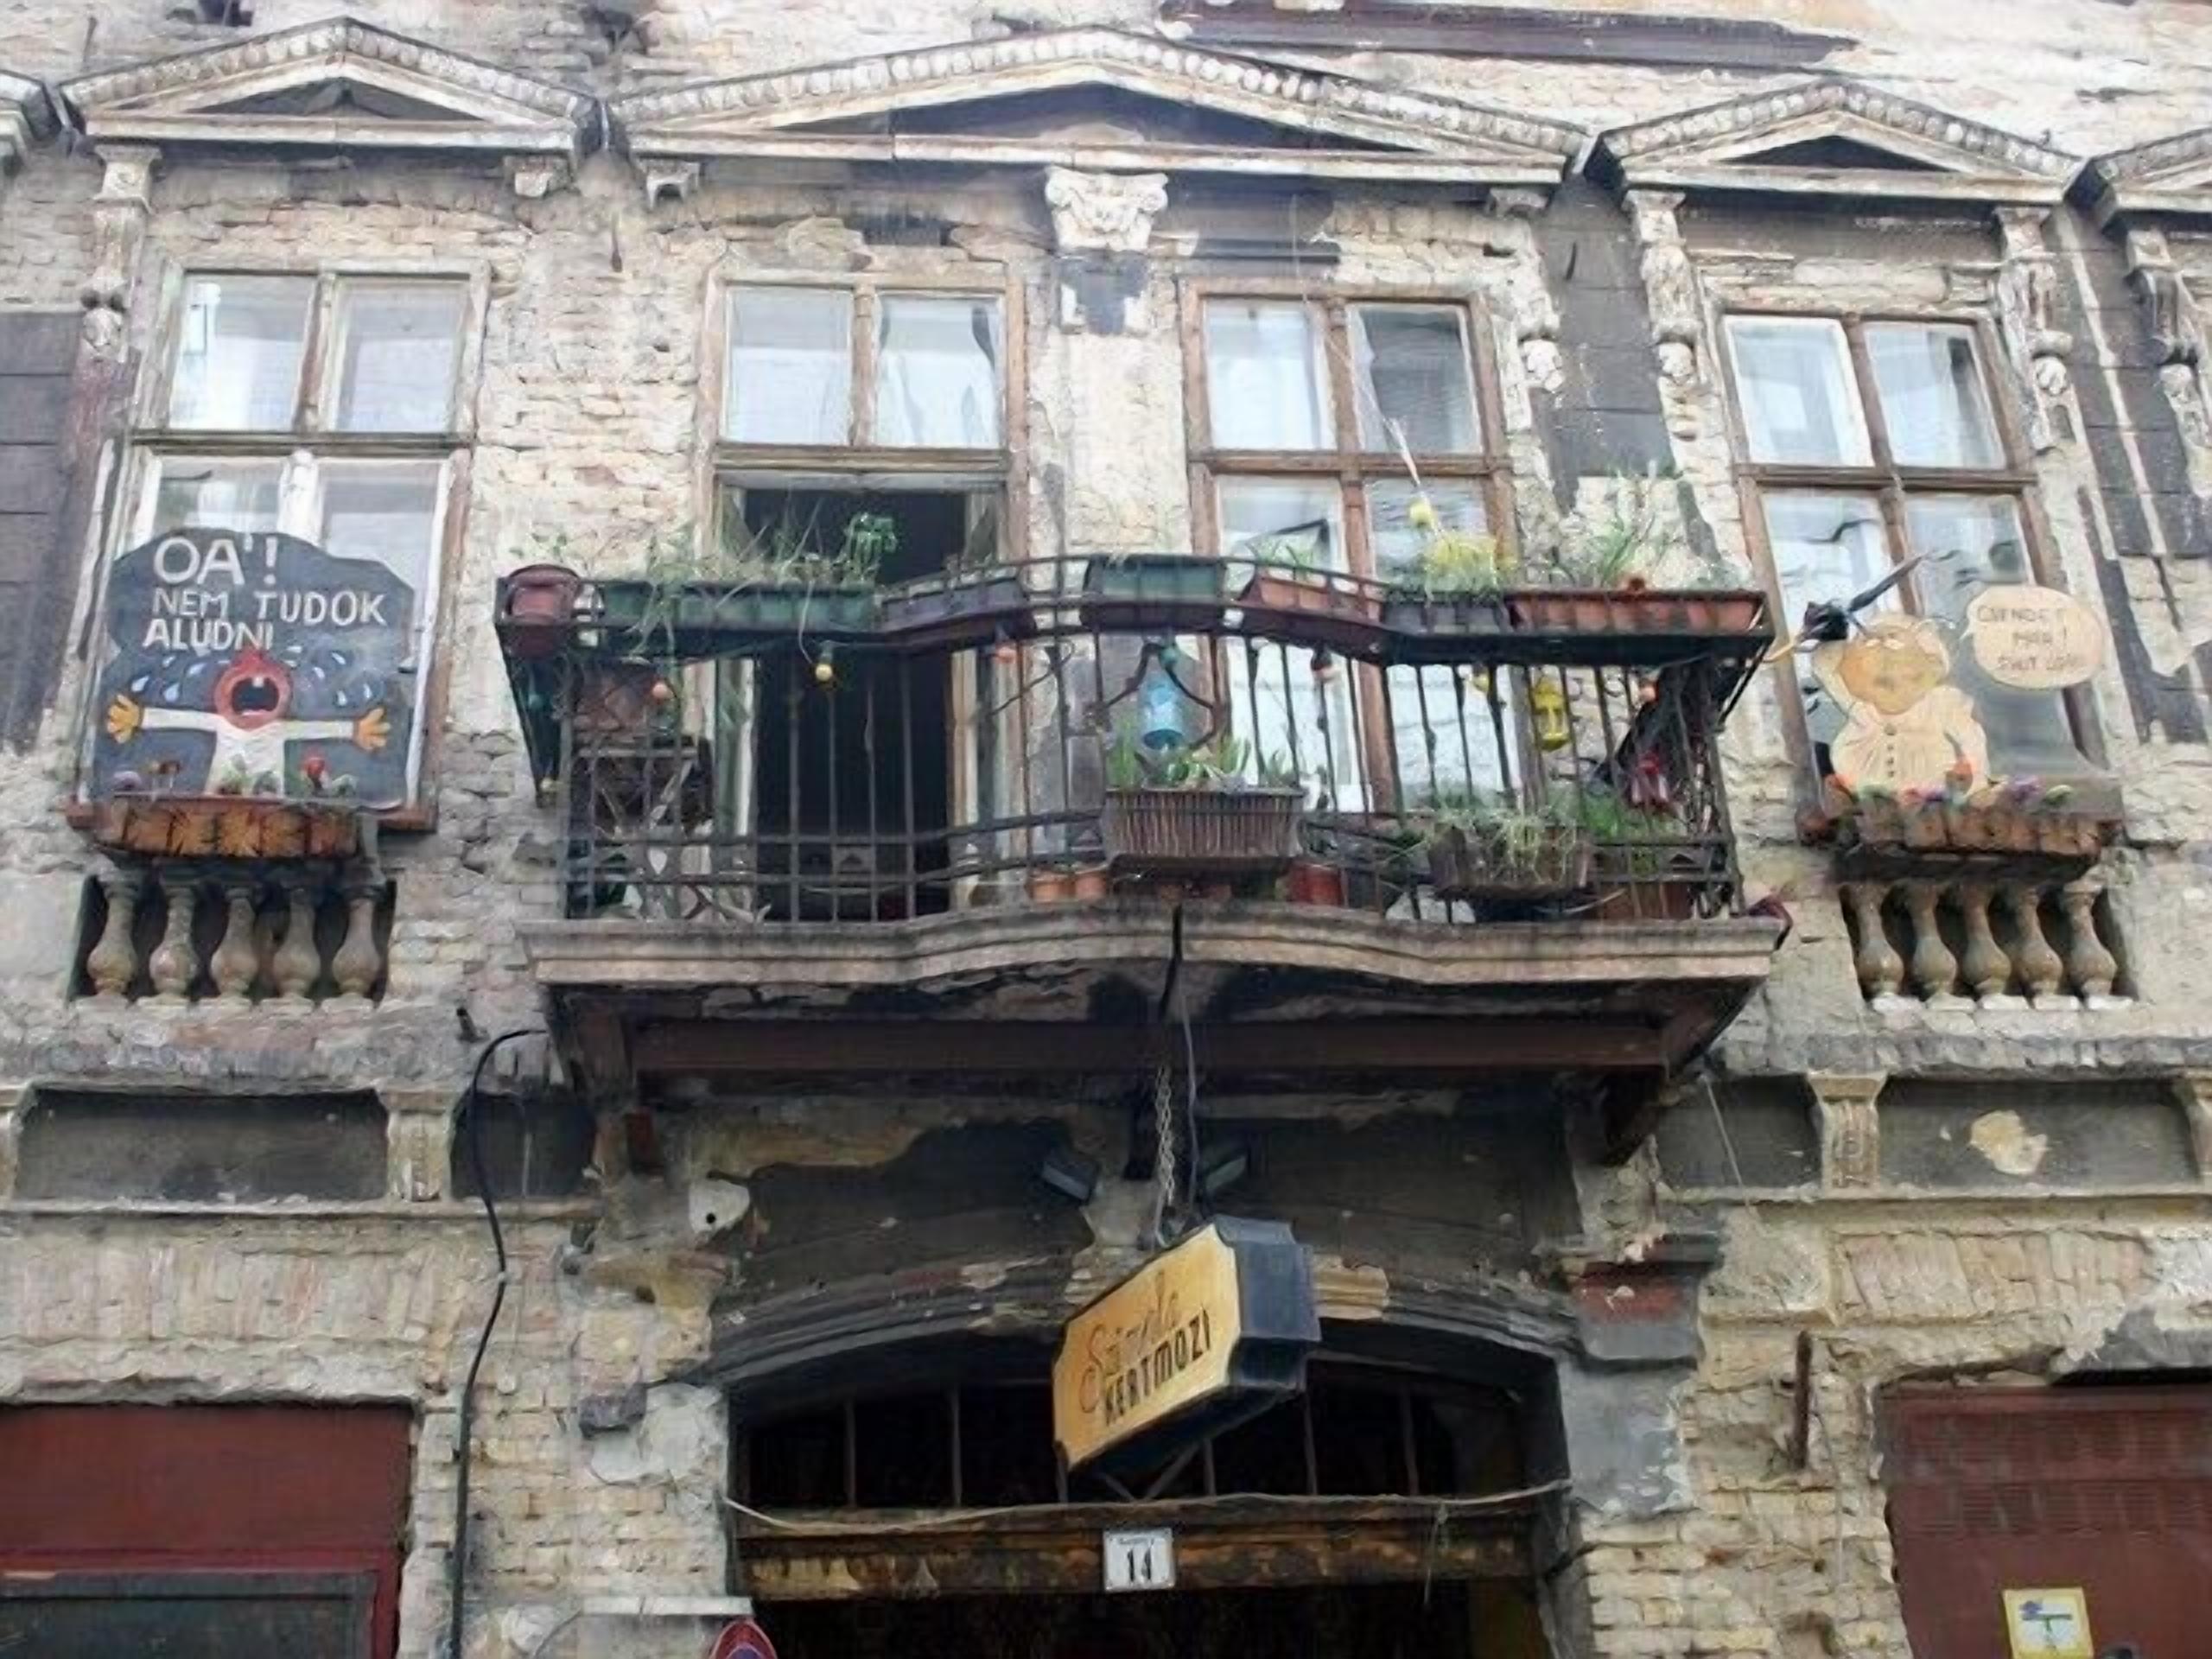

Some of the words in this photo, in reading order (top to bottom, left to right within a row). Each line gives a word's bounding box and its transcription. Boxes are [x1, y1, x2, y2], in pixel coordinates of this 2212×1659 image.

[151, 587, 228, 618] NEM
[254, 589, 388, 626] TUDOK
[142, 617, 274, 651] ALUDNI
